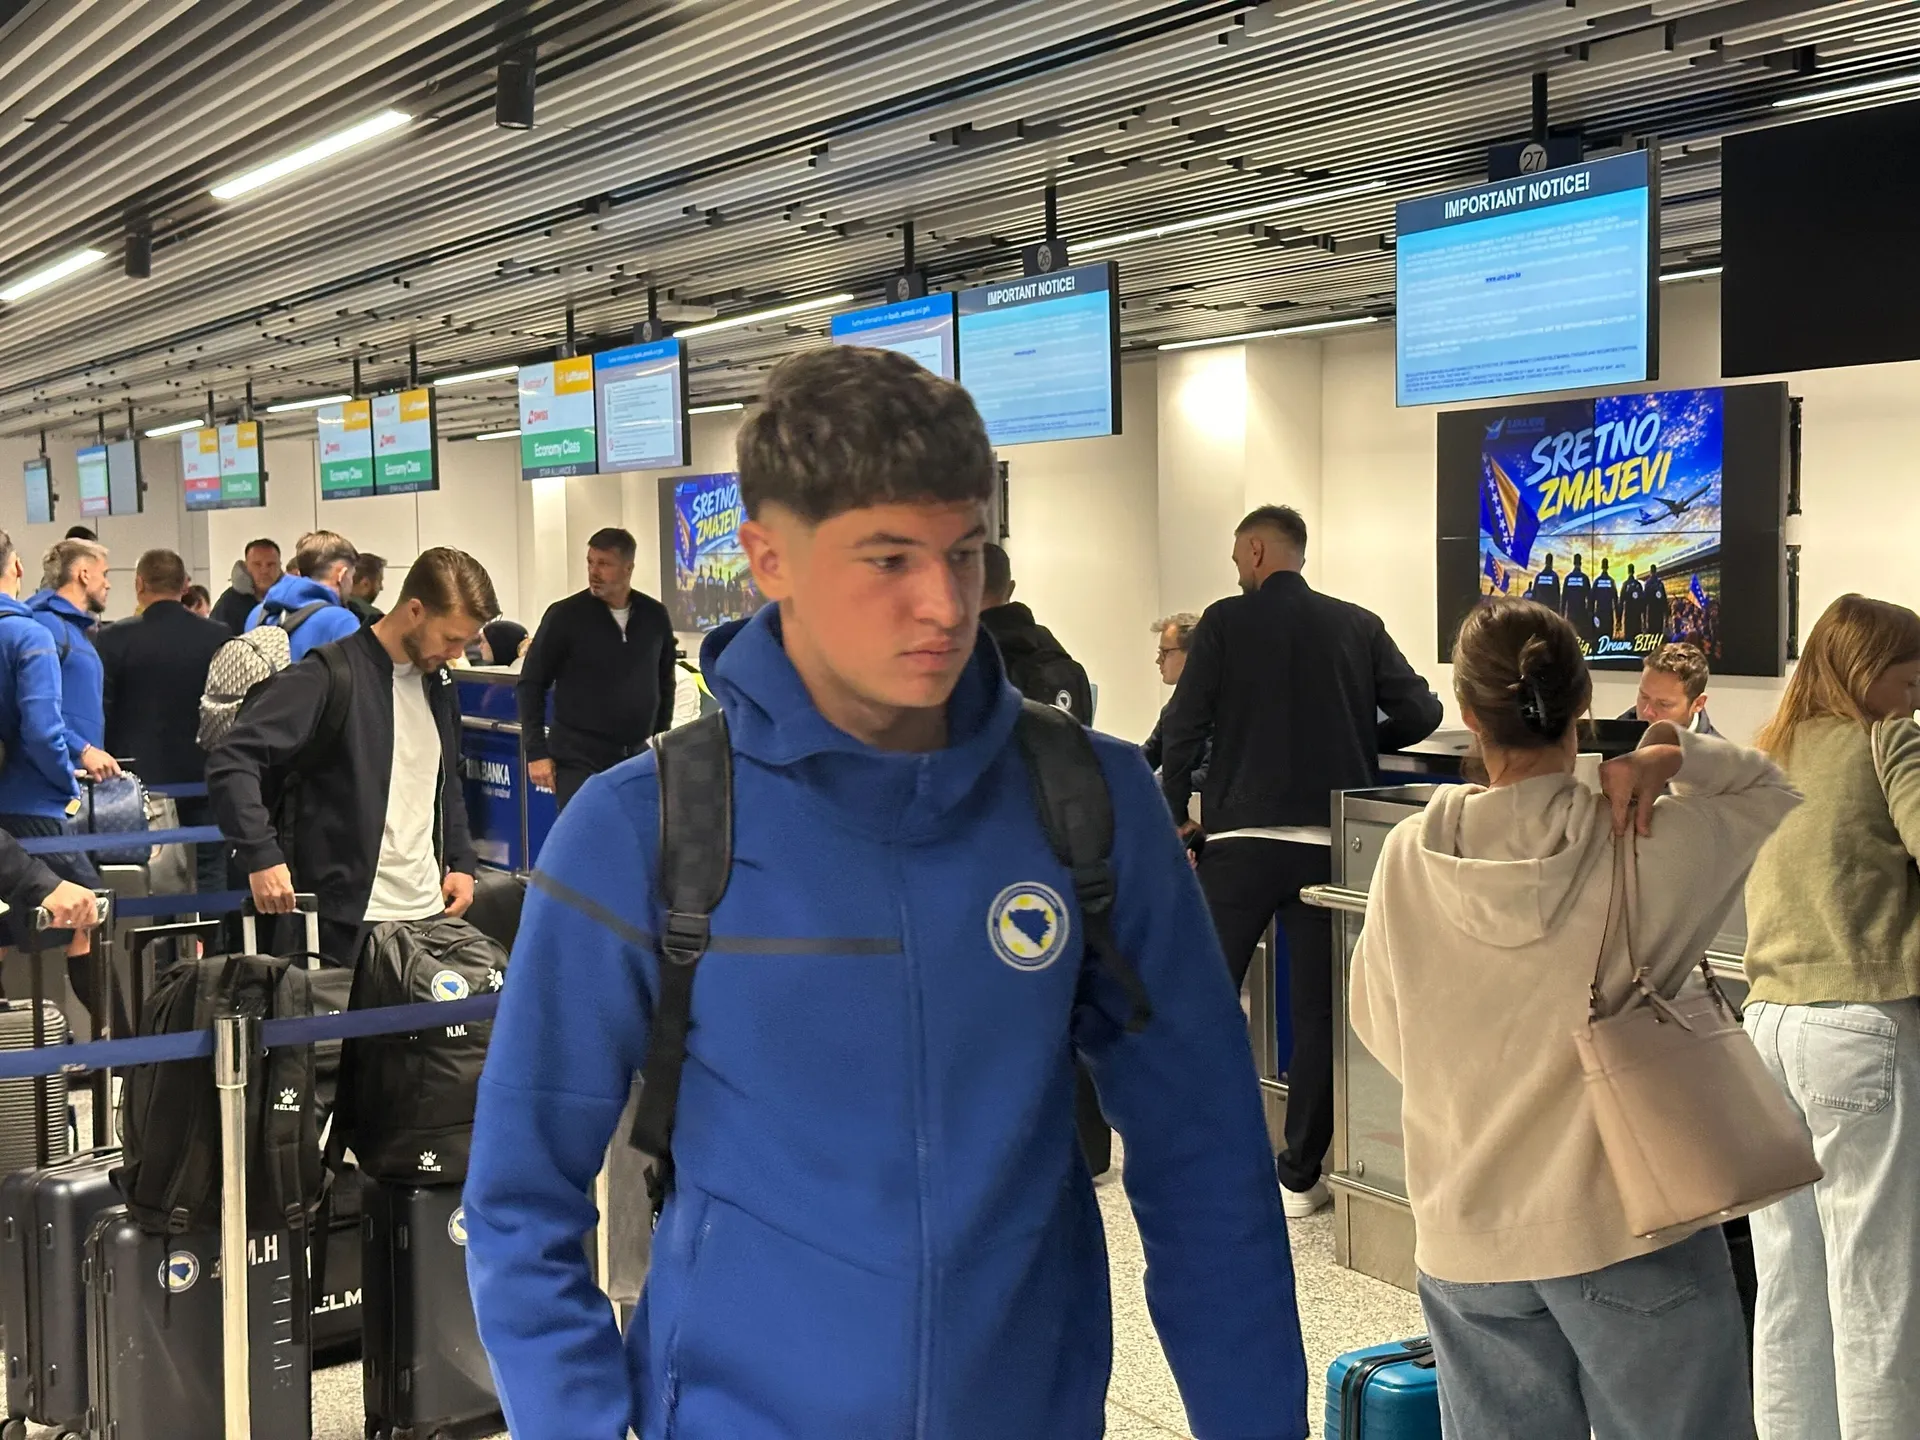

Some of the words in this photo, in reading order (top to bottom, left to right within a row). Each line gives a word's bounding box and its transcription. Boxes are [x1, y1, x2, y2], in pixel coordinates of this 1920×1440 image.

[1522, 151, 1545, 172] 27
[1444, 186, 1527, 219] IMPORTANT
[1528, 171, 1590, 202] NOTICE!
[1036, 249, 1050, 267] 26
[987, 283, 1037, 306] IMPORTANT
[1037, 276, 1076, 296] NOTICE!
[534, 442, 562, 458] Economy
[562, 439, 581, 454] Class
[1524, 412, 1661, 487] SRETNO
[1537, 451, 1673, 522] ZMAJEVI
[691, 483, 738, 525] SRETNO
[695, 506, 742, 546] ZMAJEVI
[1596, 635, 1633, 654] Dream
[1633, 633, 1664, 652] BIH!
[481, 761, 511, 786] BANKA
[446, 1024, 468, 1038] N.M.
[273, 1103, 300, 1112] KELME
[310, 1287, 363, 1315] ELM
